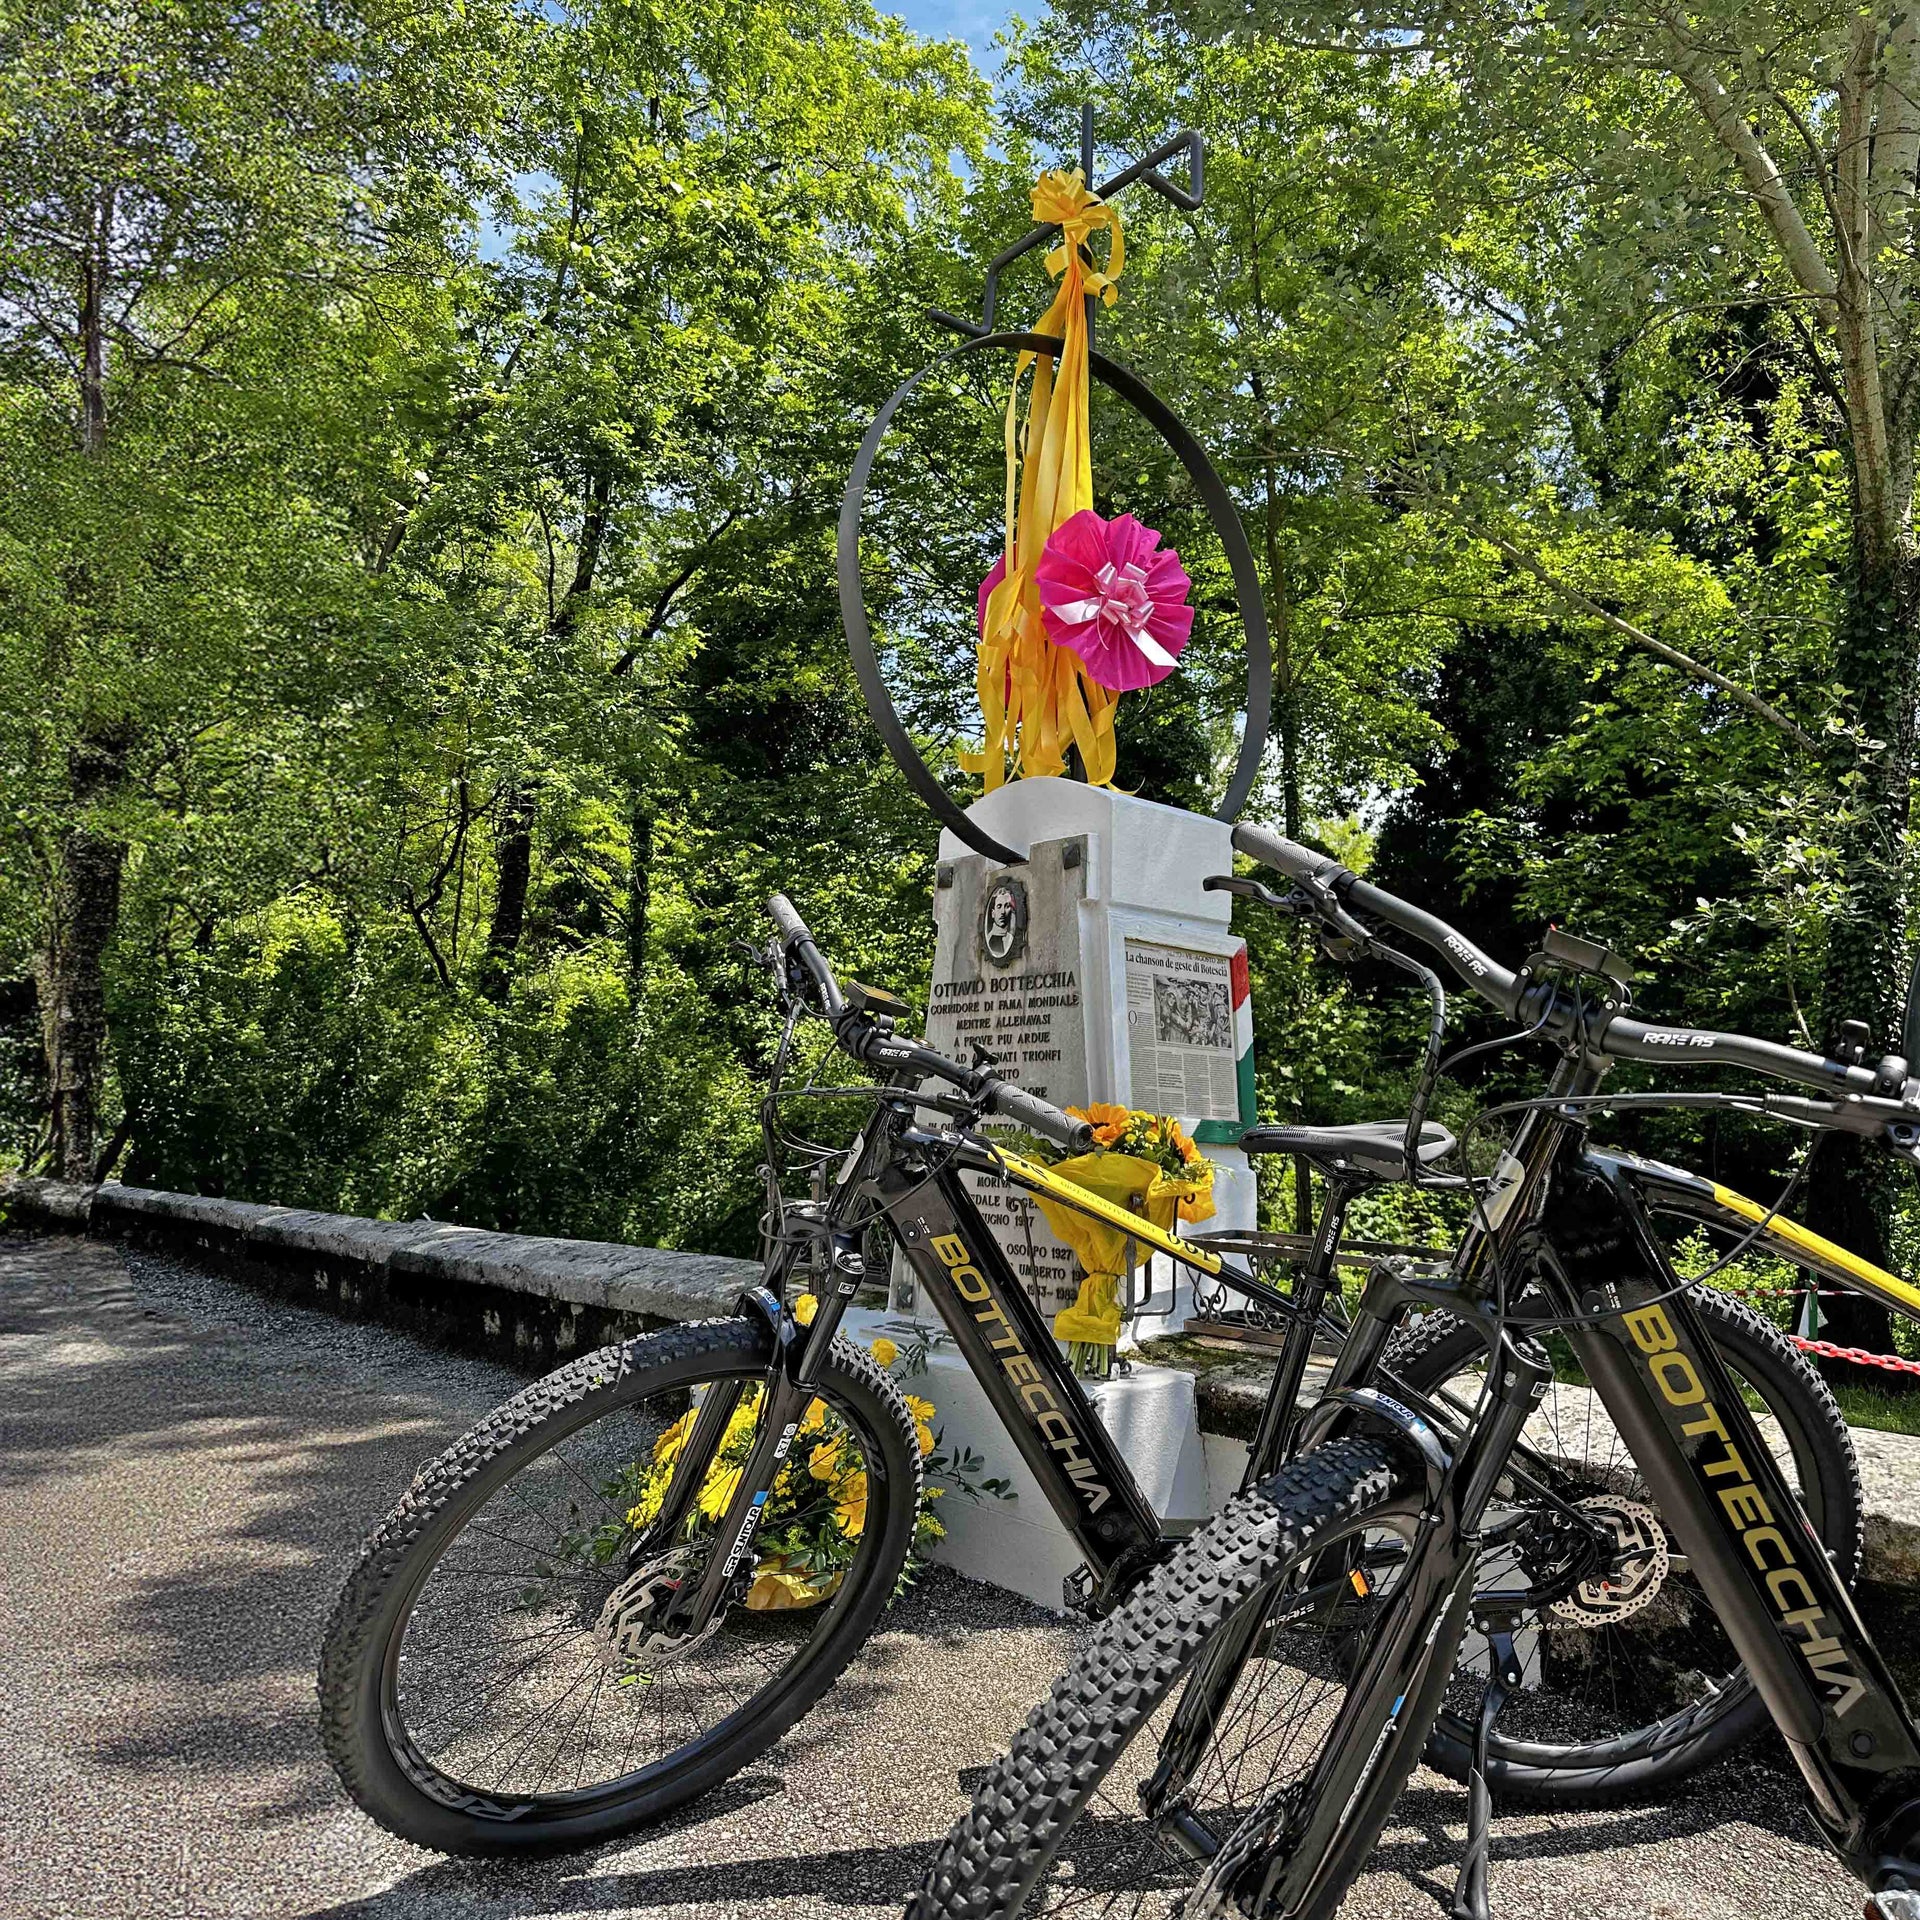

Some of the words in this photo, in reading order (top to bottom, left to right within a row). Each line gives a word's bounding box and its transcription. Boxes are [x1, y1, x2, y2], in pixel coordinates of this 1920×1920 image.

[1126, 951, 1134, 962] La
[1135, 952, 1164, 967] chanson
[1165, 957, 1174, 969] de
[1175, 961, 1192, 972] geste
[933, 979, 985, 998] OTTAVIO
[990, 971, 1076, 994] BOTTECCHIA
[931, 1001, 980, 1015] CORRIDORE
[984, 1000, 994, 1012] DI
[998, 998, 1023, 1011] FAMA
[1028, 994, 1080, 1009] MONDIALE
[956, 1017, 991, 1030] MENTRE
[996, 1014, 1051, 1028] ALLENAVASI
[954, 1036, 960, 1047] A
[964, 1034, 993, 1047] PROVE
[997, 1033, 1013, 1045] PIU
[1017, 1031, 1050, 1044] ARDUE
[955, 1052, 967, 1064] AD
[1022, 1049, 1061, 1062] TRIONFI
[1015, 1215, 1035, 1228] 197
[1051, 1247, 1073, 1261] 1927
[929, 1234, 1112, 1514] BOTTECCHIA
[1621, 1304, 1866, 1719] BOTTECCHIA
[733, 1507, 760, 1556] SUNTOUR
